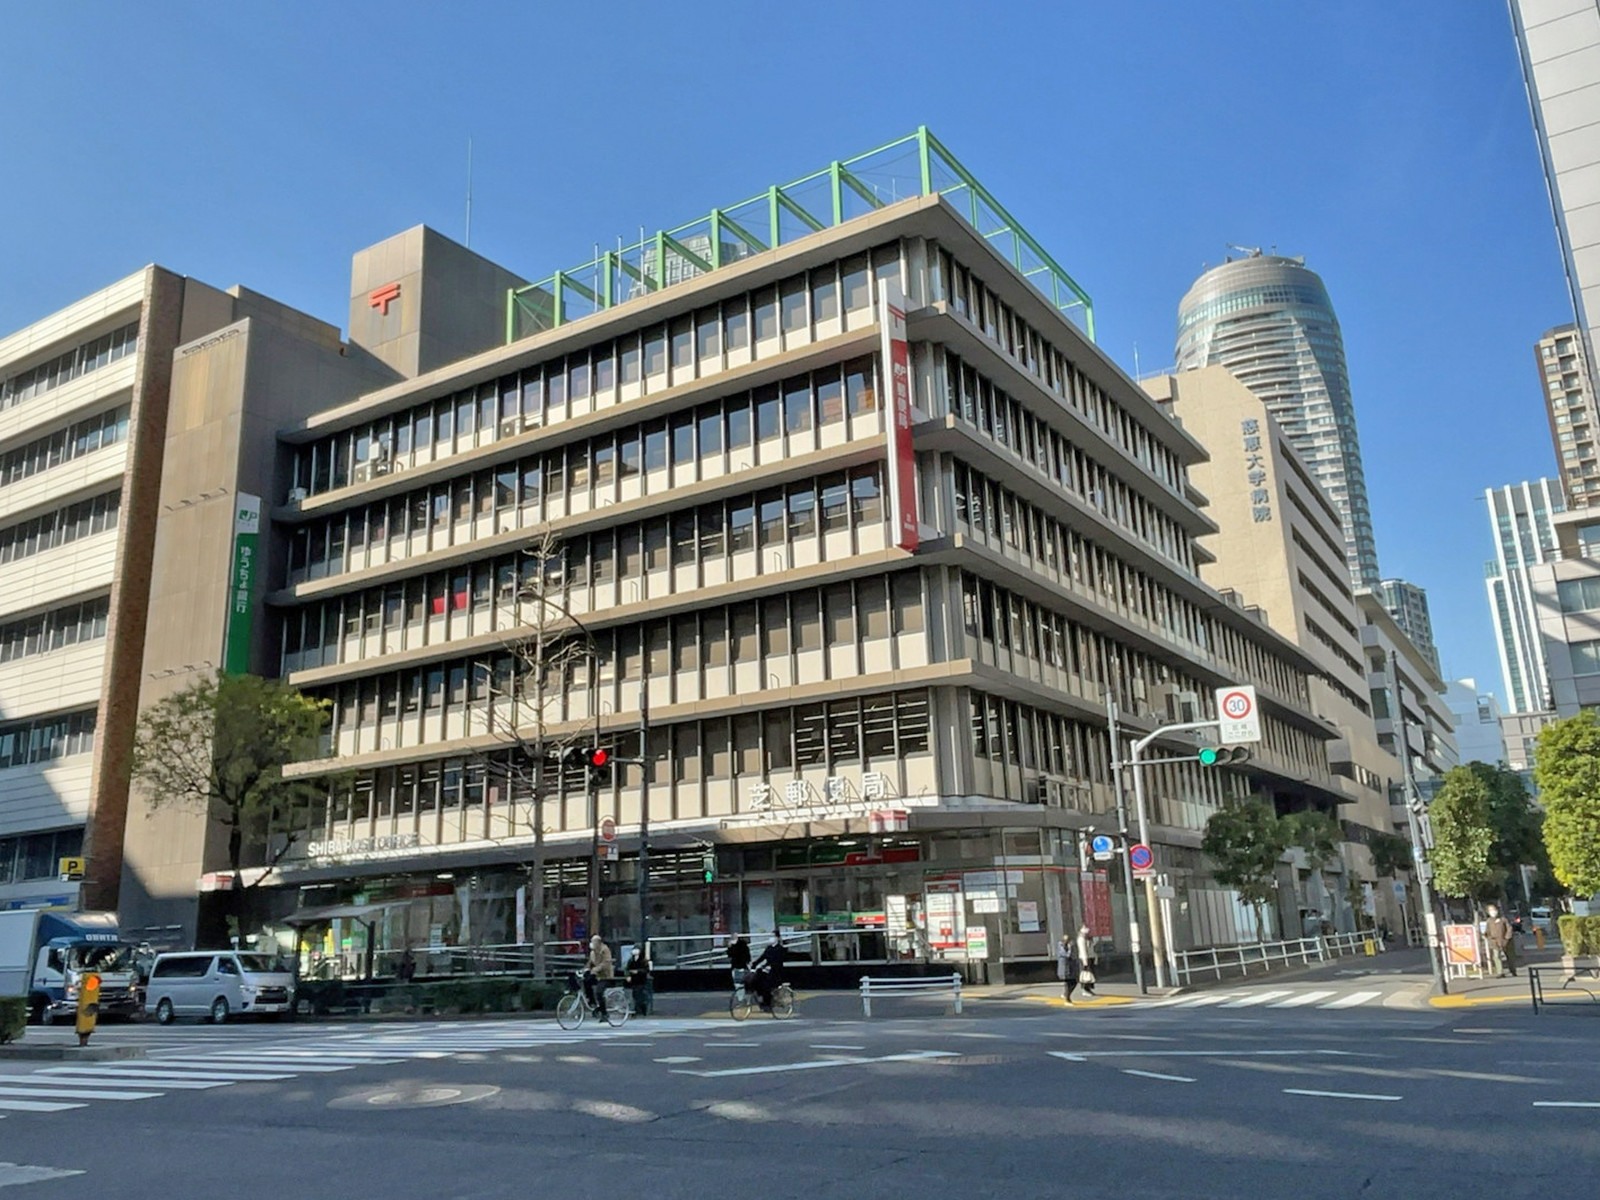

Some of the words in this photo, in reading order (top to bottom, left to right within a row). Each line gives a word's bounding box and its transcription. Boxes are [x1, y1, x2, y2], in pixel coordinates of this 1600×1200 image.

[1229, 699, 1245, 712] 30
[748, 772, 885, 810] 芝郵便局
[307, 840, 342, 857] SHIBA
